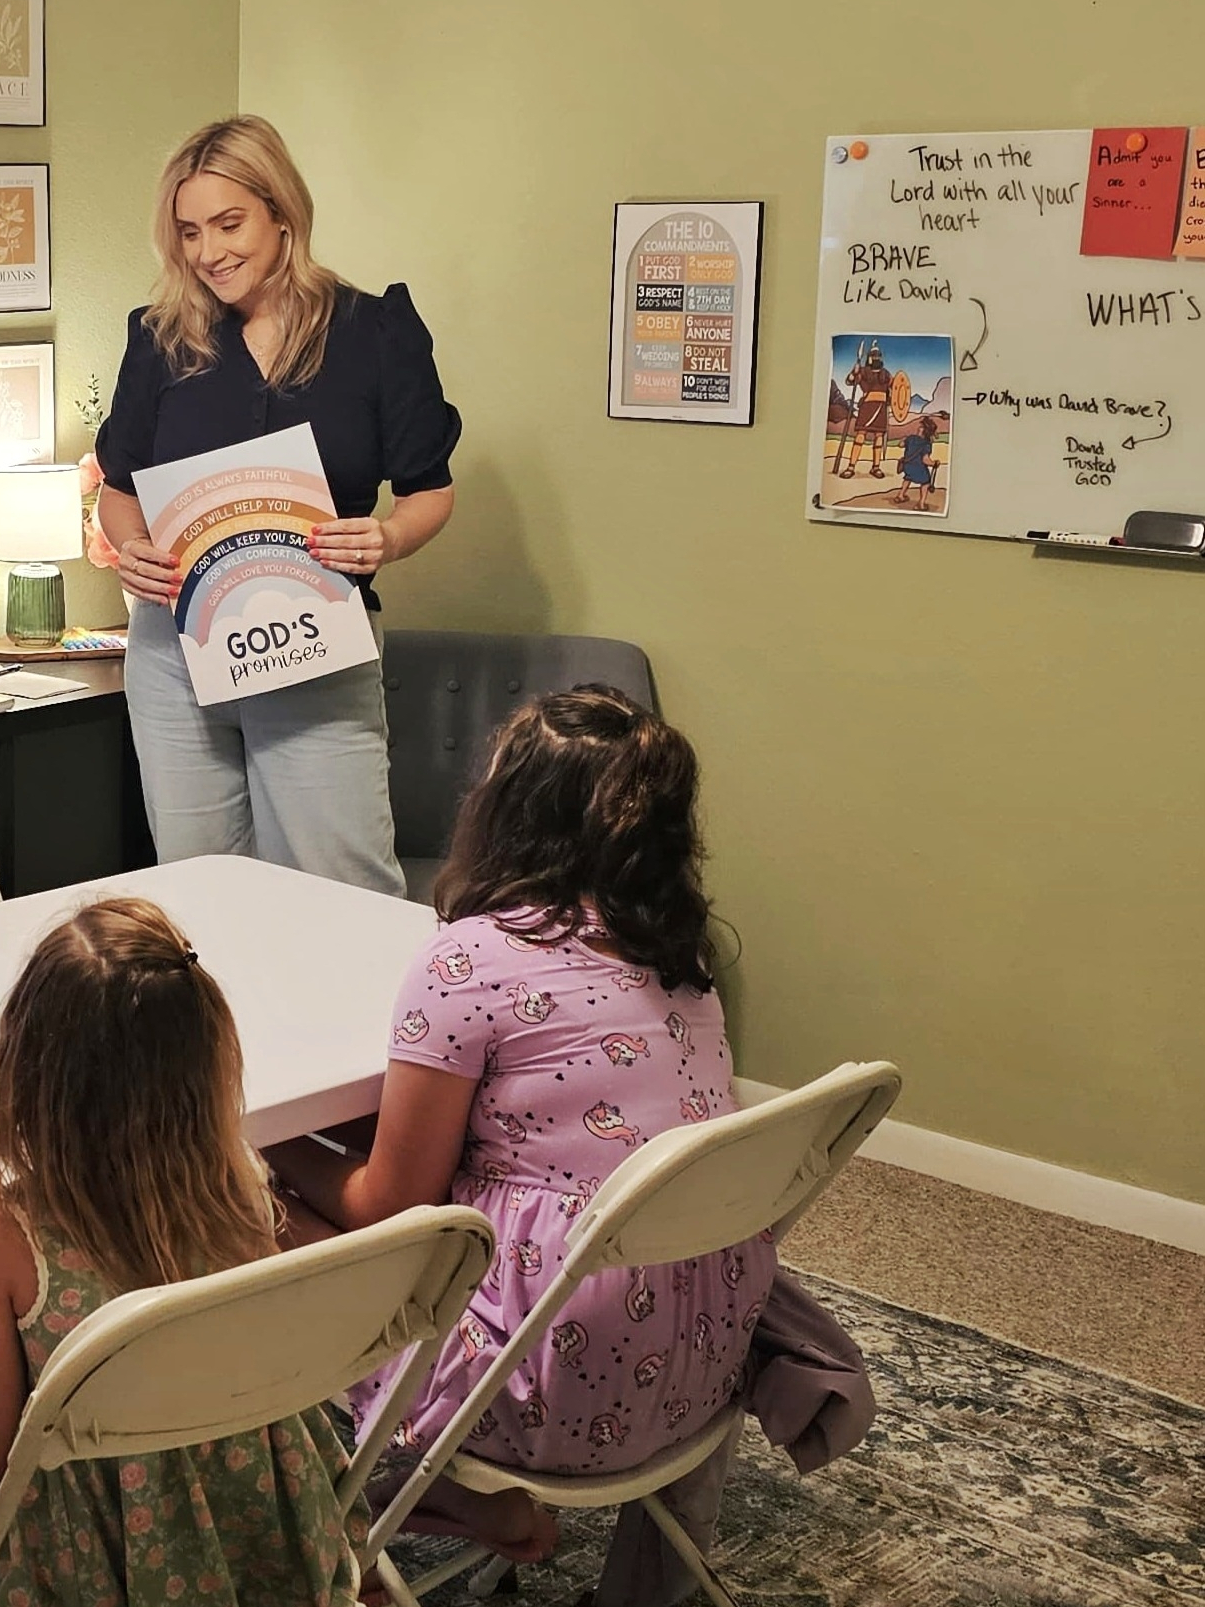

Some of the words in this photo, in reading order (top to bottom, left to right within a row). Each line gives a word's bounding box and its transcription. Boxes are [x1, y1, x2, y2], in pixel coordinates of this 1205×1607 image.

[908, 145, 963, 172] Trust
[972, 149, 993, 169] in
[997, 144, 1033, 167] the
[1097, 145, 1142, 166] Admit
[1150, 153, 1172, 169] you
[1107, 178, 1125, 187] are
[1139, 179, 1146, 187] a
[890, 179, 935, 203] Lord
[943, 177, 988, 202] with
[997, 179, 1026, 201] all
[1032, 182, 1080, 216] your
[918, 203, 980, 232] heart
[1186, 216, 1205, 226] Cro
[665, 221, 694, 240] THE
[698, 219, 714, 239] 10
[644, 240, 731, 252] COMMANDMENTS
[1183, 233, 1205, 244] you
[639, 255, 644, 267] 1
[645, 256, 660, 265] PUT
[663, 256, 681, 265] GOD
[688, 257, 696, 267] 2
[696, 260, 735, 269] WORSHIP
[847, 243, 936, 275] BRAVE
[644, 265, 682, 280] FIRST
[637, 286, 645, 297] 3
[645, 287, 683, 298] RESPECT
[687, 286, 695, 298] 4
[843, 278, 891, 304] Like
[899, 279, 952, 303] David
[638, 298, 660, 307] GOD'S
[662, 299, 683, 308] NAME
[696, 295, 712, 305] 7TH
[714, 295, 731, 305] DAY
[1087, 288, 1202, 326] WHAT'S
[636, 315, 644, 326] 5
[646, 316, 680, 330] OBEY
[686, 316, 694, 327] 6
[686, 327, 731, 340] ANYONE
[635, 344, 643, 356] 7
[641, 351, 680, 362] WEDDING
[684, 345, 692, 357] 8
[693, 346, 706, 356] DO
[708, 347, 726, 357] NOT
[690, 357, 728, 371] STEAL
[634, 375, 642, 385] 9
[641, 376, 677, 388] ALWAYS
[683, 375, 696, 388] 10
[989, 389, 1021, 417] Why
[1058, 393, 1099, 414] David
[1065, 436, 1105, 455] David
[1062, 456, 1117, 473] Trusted
[1075, 472, 1112, 486] GOD
[174, 493, 192, 511] GOD
[193, 487, 204, 497] IS
[204, 473, 242, 492] ALWAYS
[245, 470, 294, 482] FAITHFUL
[183, 521, 204, 542] GOD
[205, 507, 234, 525] WILL
[234, 500, 264, 514] HELP
[267, 500, 292, 512] YOU
[194, 555, 211, 575] GOD
[212, 542, 235, 559] WILL
[236, 533, 261, 548] KEEP
[263, 532, 286, 543] YOU
[289, 534, 308, 547] SAF
[205, 567, 222, 586] GOD
[222, 554, 245, 570] WILL
[246, 548, 291, 562] COMFORT
[294, 551, 313, 566] YOU
[208, 590, 223, 607] GOD
[222, 576, 241, 591] WILL
[241, 564, 261, 578] LOVE
[263, 564, 283, 573] YOU
[285, 565, 322, 586] FOREVER
[227, 612, 320, 660] GOD'S
[229, 641, 329, 688] promises
